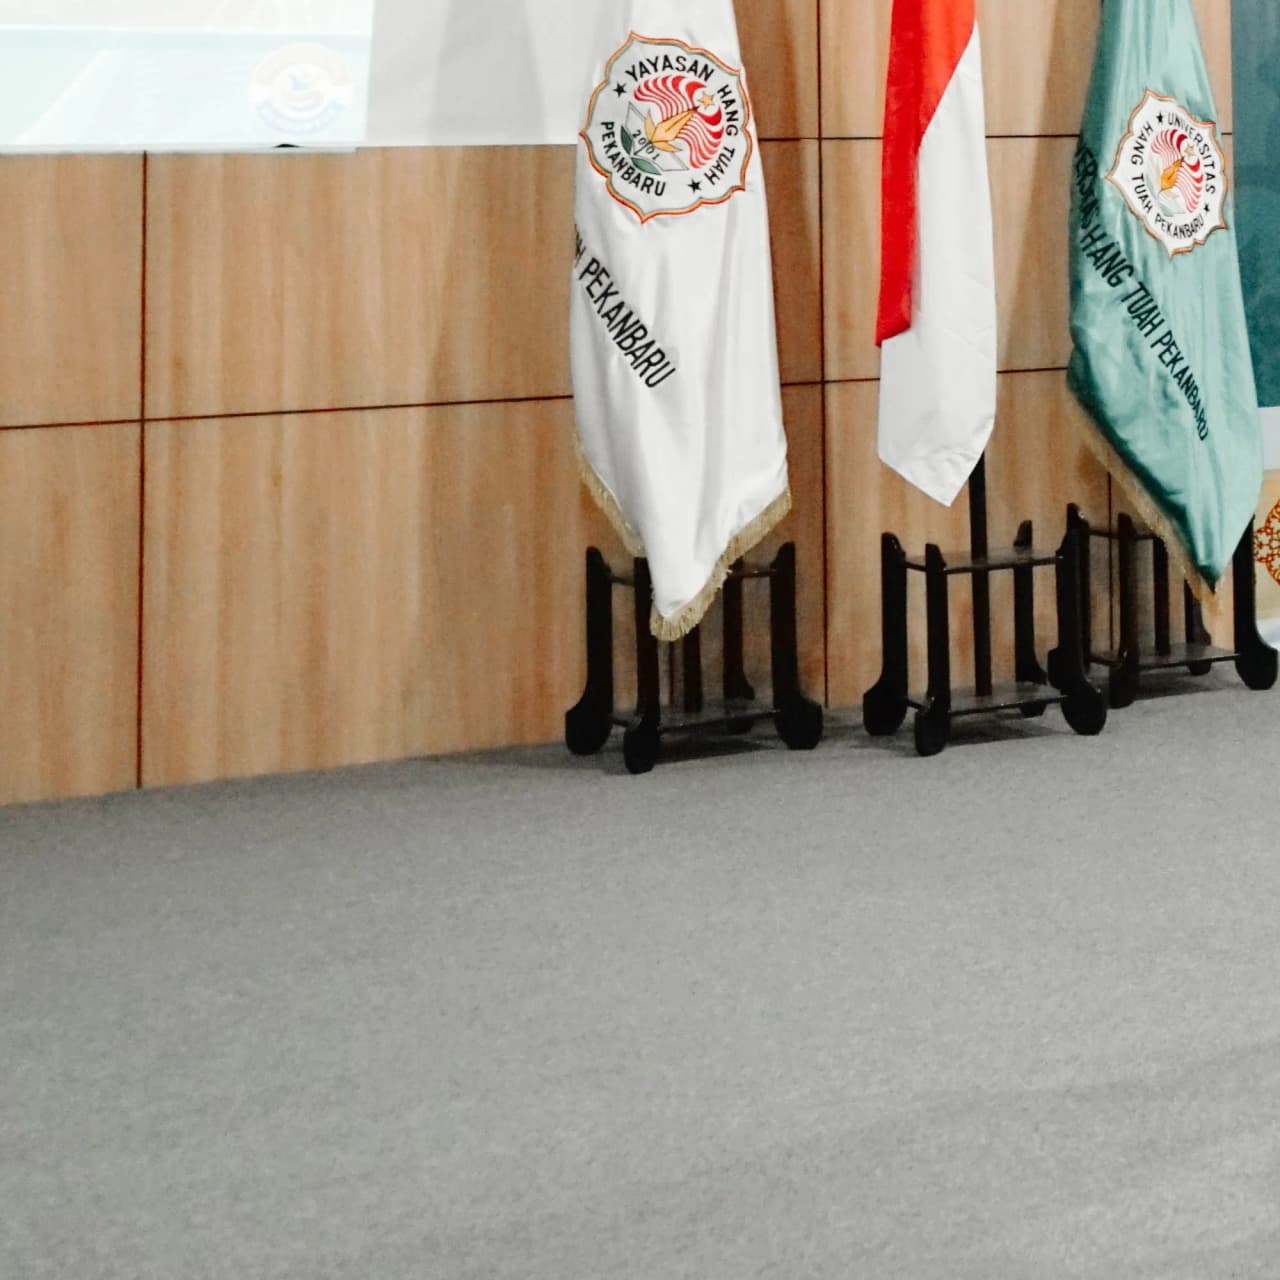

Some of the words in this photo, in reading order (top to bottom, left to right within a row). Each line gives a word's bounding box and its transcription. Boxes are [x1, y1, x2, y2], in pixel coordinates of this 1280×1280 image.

[625, 54, 714, 82] YAYASAN
[717, 84, 739, 137] HANG
[600, 121, 666, 197] PEKANBARU
[632, 129, 661, 161] 2001
[704, 146, 736, 186] TUAH
[1131, 122, 1154, 166] HANG
[1168, 112, 1216, 195] UNIVERSITAS
[1131, 173, 1153, 214] TUAH
[1155, 213, 1205, 239] PEKANBARU
[578, 256, 676, 388] PEKANBARU
[1080, 223, 1134, 288] HANG
[1121, 281, 1165, 350] TUAH
[1160, 329, 1209, 442] PEKANBARU
